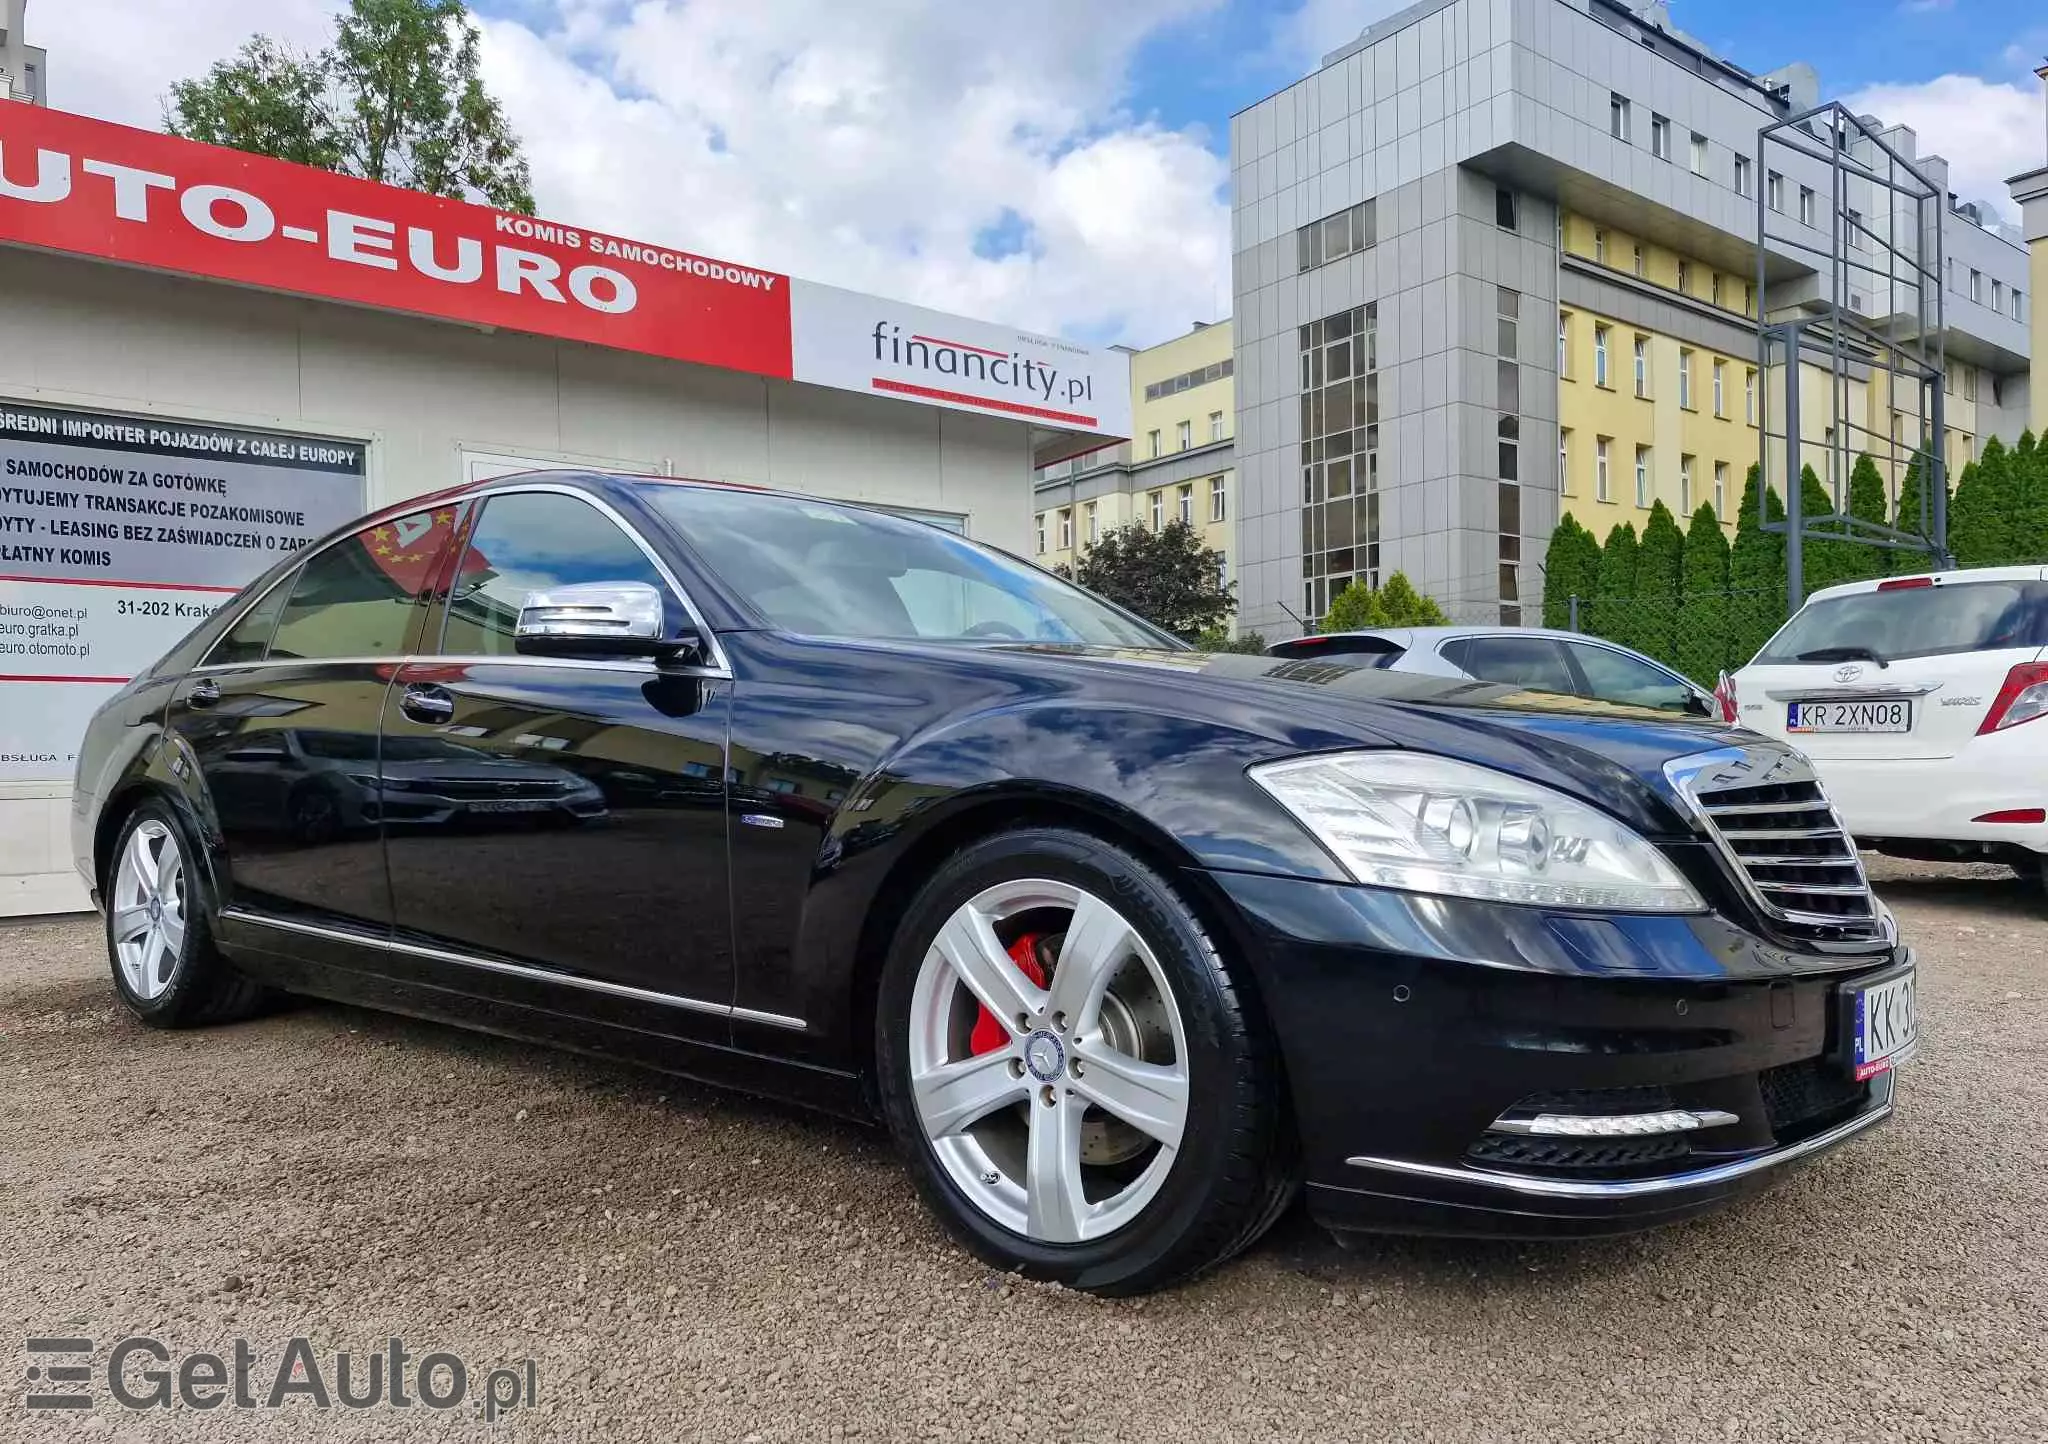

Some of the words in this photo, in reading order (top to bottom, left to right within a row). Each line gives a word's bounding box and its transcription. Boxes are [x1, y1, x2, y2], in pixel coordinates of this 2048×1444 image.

[495, 214, 581, 249] KOMIS
[588, 235, 776, 292] SAMOCHODOWY
[872, 320, 1093, 405] financity.pl
[62, 419, 146, 445] IMPORTER
[150, 430, 234, 454] POJAZDÓW
[237, 439, 247, 455] Z
[250, 440, 296, 460] CAŁEJ
[299, 445, 356, 466] EUROPY
[6, 458, 124, 485] SAMOCHODÓW
[128, 469, 148, 487] ZA
[153, 471, 227, 498] GOTÓWKĘ
[0, 487, 79, 509] YTUJEMY
[84, 494, 186, 519] TRANSAKCJE
[190, 502, 305, 527] POZAKOMISOWE
[0, 515, 35, 534] YTY
[50, 519, 119, 540] LEASING
[123, 525, 153, 543] BEZ
[157, 526, 262, 550] ZAŚWIADCZEŃ
[266, 535, 276, 550] O
[0, 544, 55, 563] ŁATNY
[60, 548, 112, 567] KOMIS
[117, 599, 170, 616] 31-202
[1801, 705, 1827, 726] KR
[1835, 704, 1902, 725] 2XN08
[1870, 986, 1896, 1054] KK
[1855, 1036, 1864, 1054] PL
